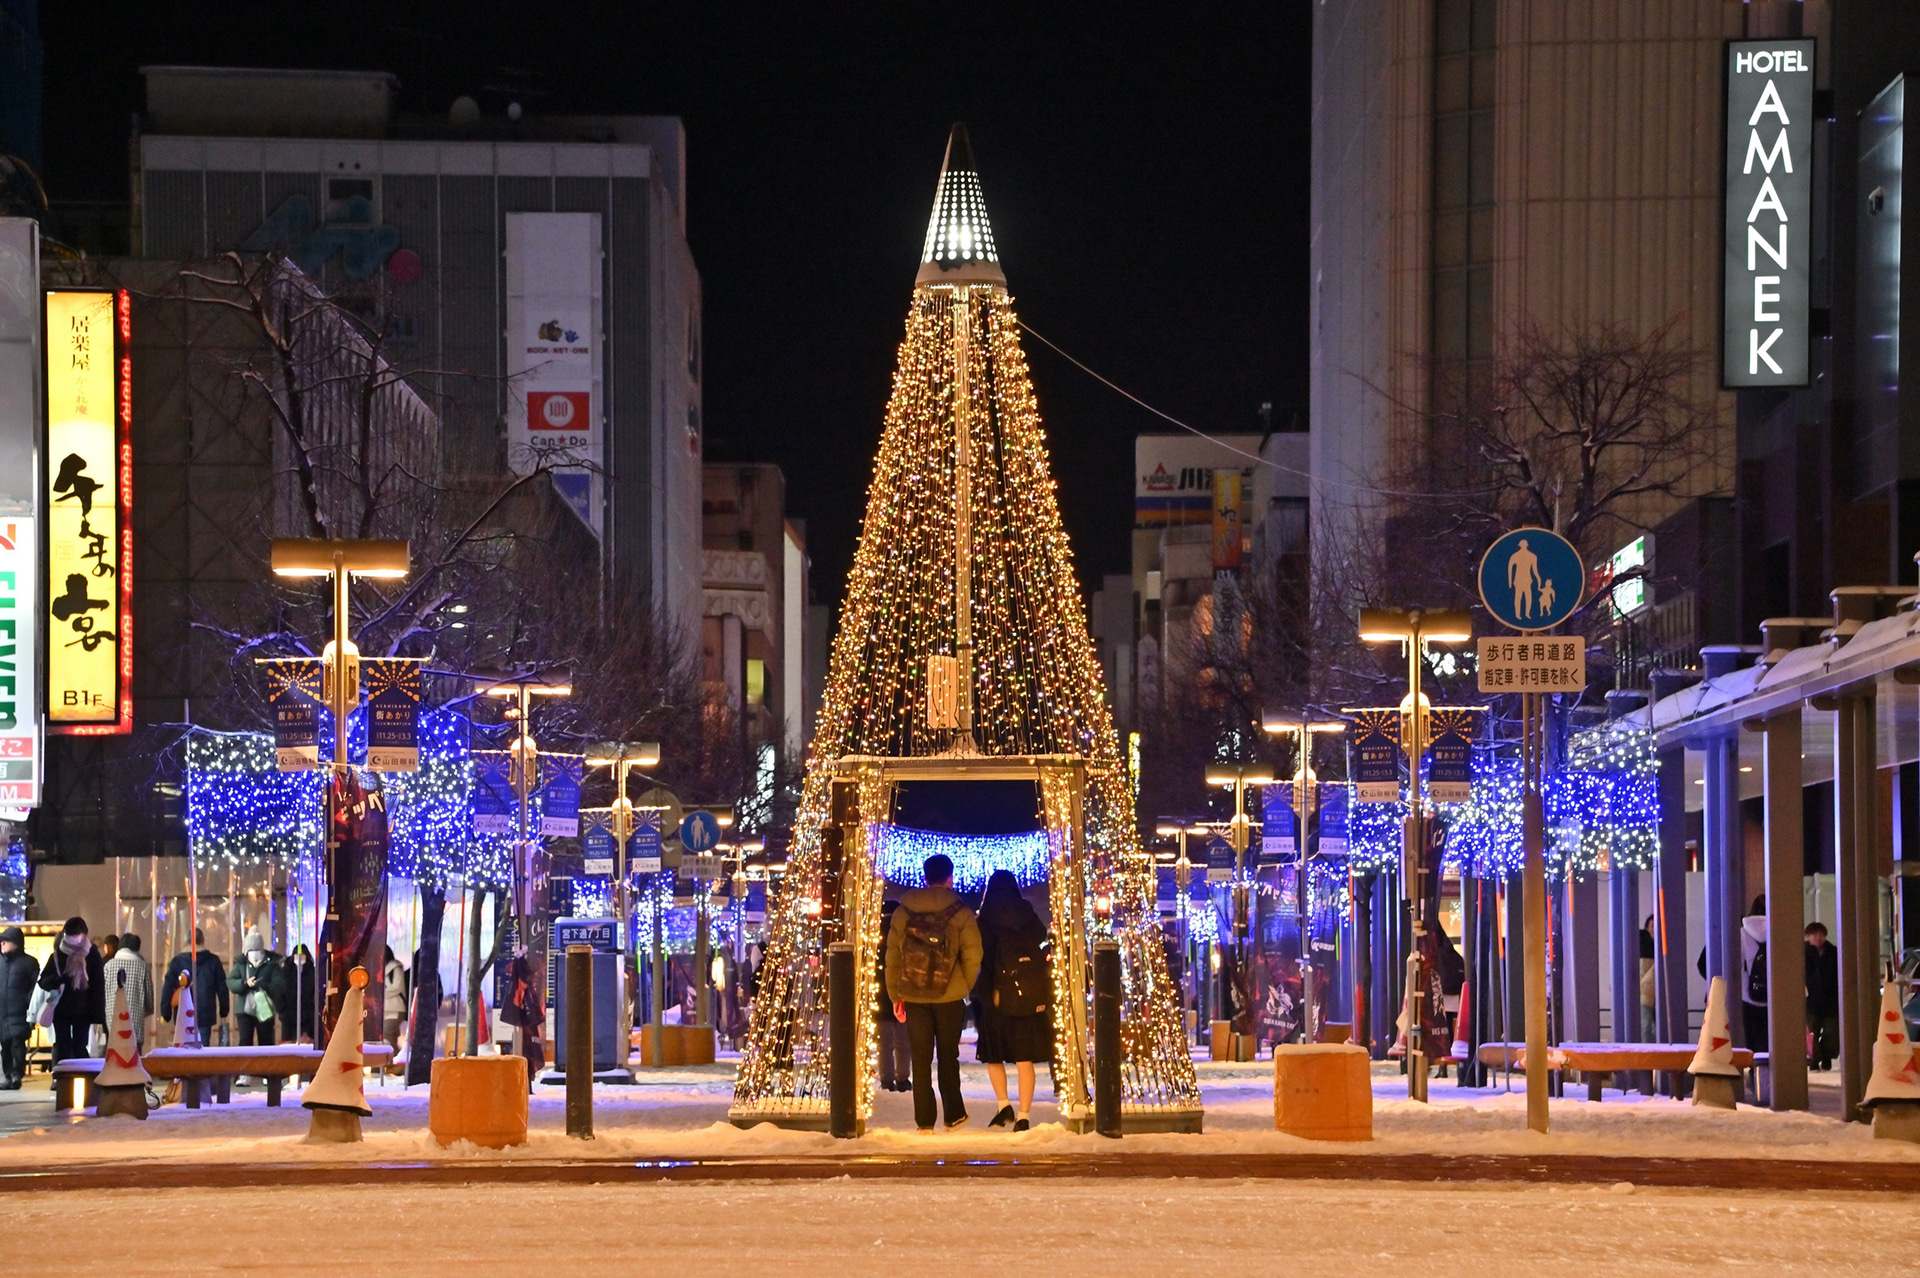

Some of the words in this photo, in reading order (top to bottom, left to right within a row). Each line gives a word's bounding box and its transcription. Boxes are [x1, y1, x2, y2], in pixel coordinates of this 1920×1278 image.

[1735, 50, 1808, 73] HOTEL
[1743, 79, 1794, 374] AMANEK
[71, 315, 90, 371] 居楽屋
[549, 402, 568, 417] 100
[52, 453, 116, 652] 千年の宴
[1486, 643, 1575, 661] 歩行者用道路
[1484, 667, 1579, 686] 指定車・許可車を除く
[63, 690, 103, 706] B1F
